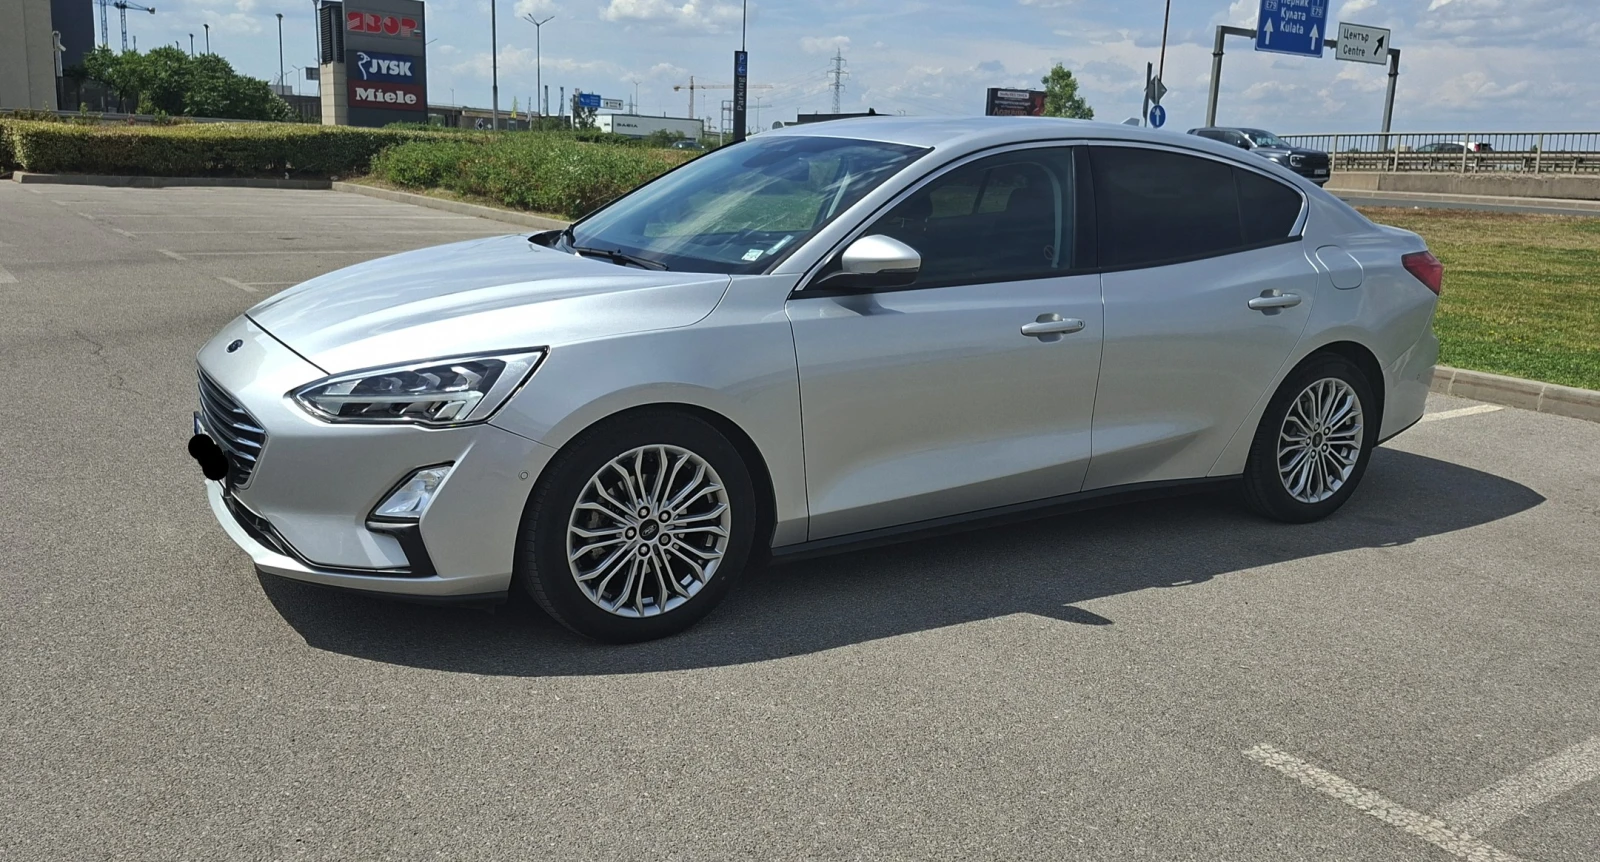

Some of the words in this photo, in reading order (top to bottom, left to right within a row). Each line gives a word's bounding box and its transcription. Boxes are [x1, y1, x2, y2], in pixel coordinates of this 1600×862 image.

[1280, 7, 1307, 21] Кулата
[1280, 21, 1304, 34] Kulata
[1343, 28, 1370, 44] Център
[1343, 44, 1366, 57] Centre
[369, 59, 412, 76] JYSK
[355, 87, 417, 104] Miele
[737, 77, 746, 111] Parking
